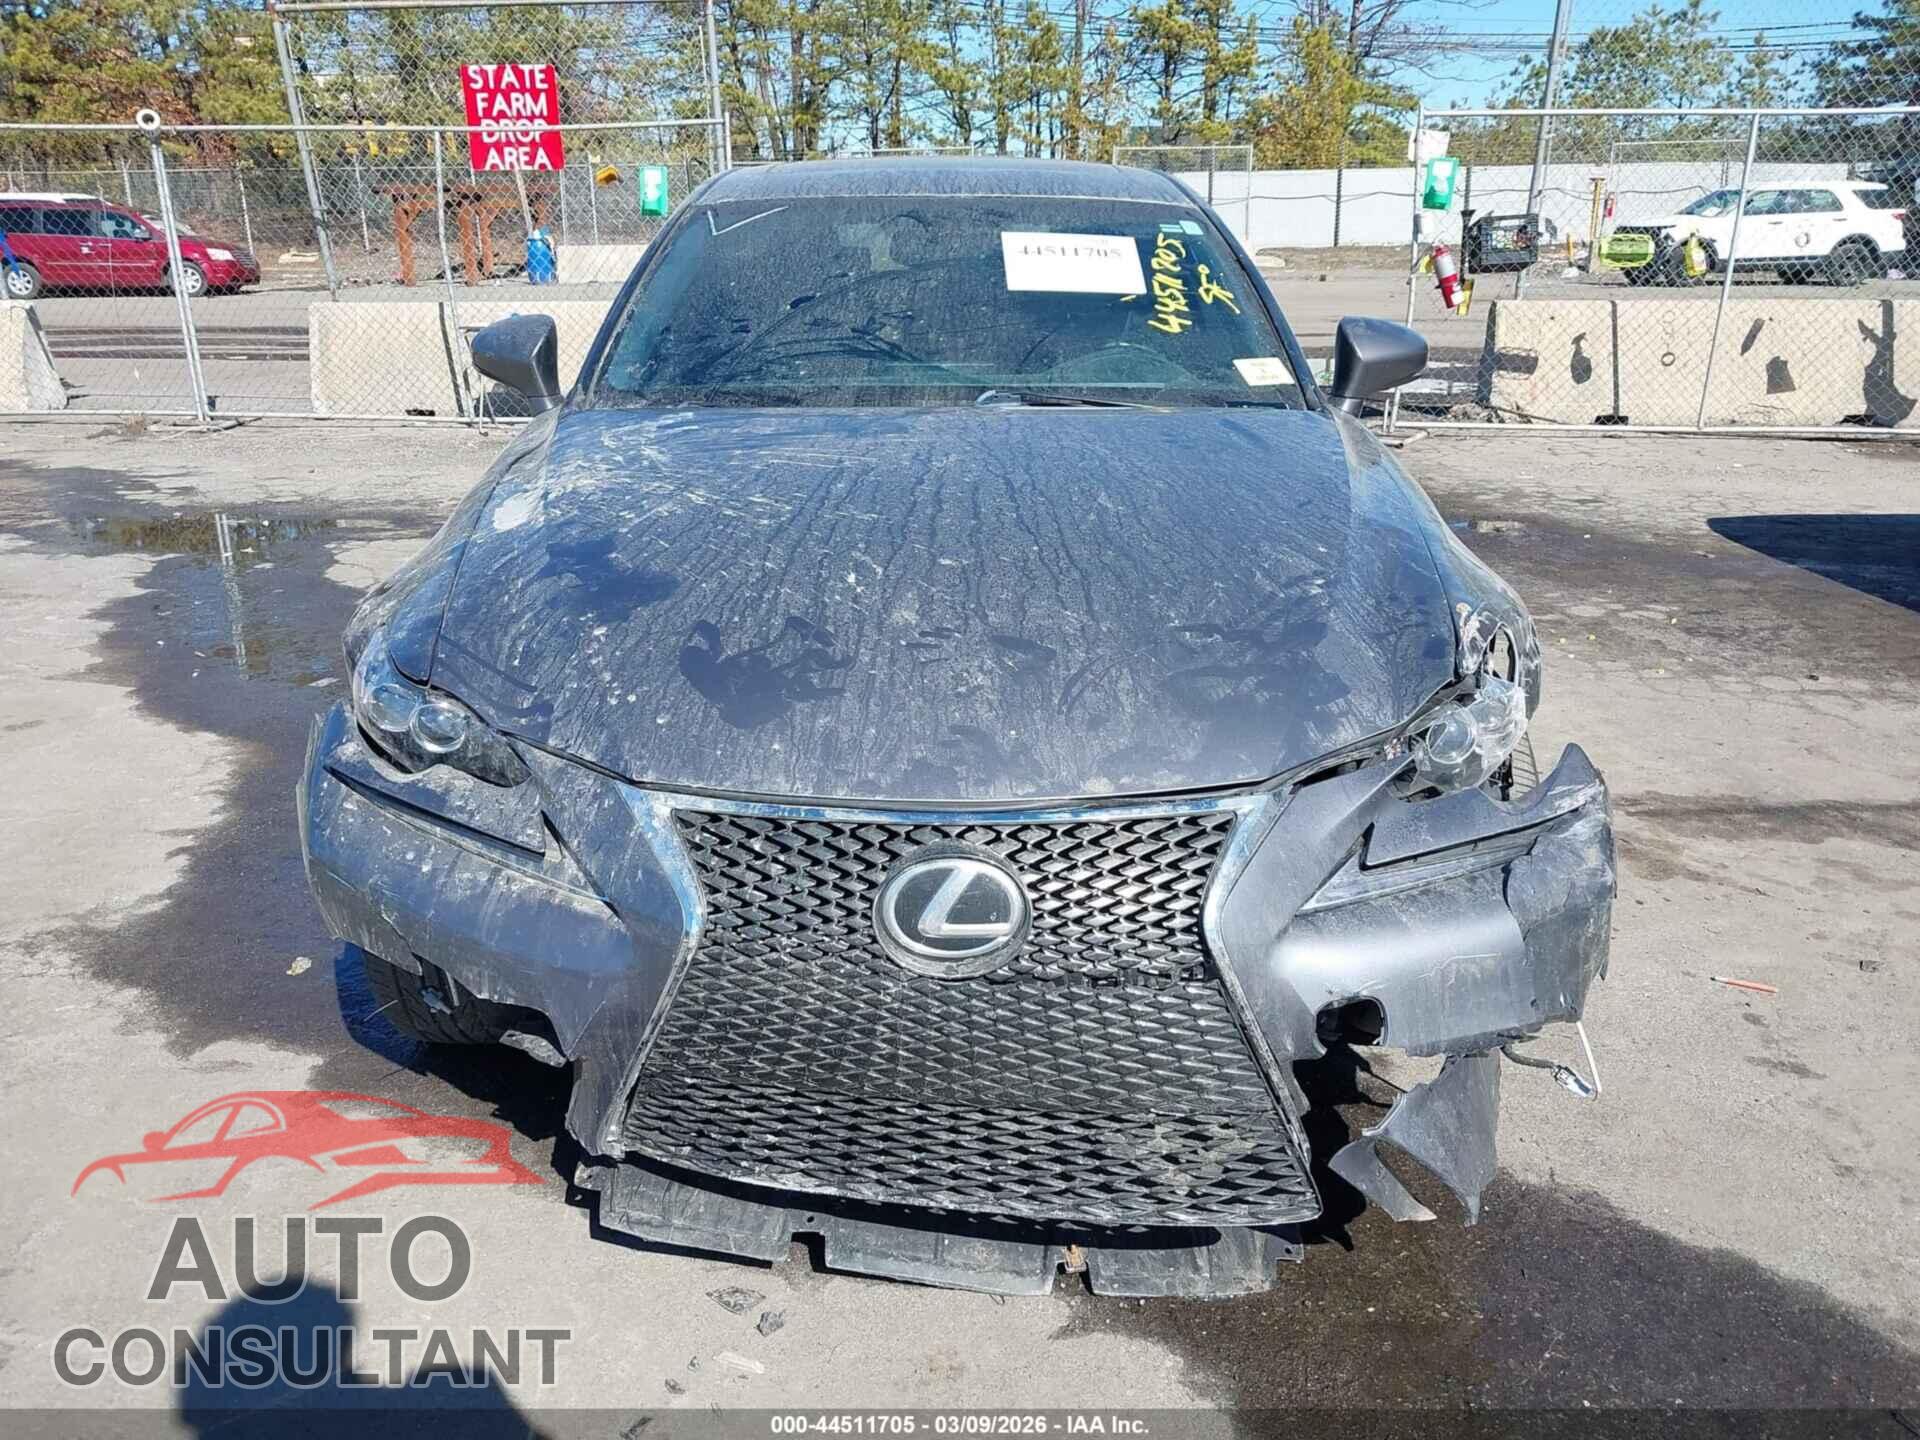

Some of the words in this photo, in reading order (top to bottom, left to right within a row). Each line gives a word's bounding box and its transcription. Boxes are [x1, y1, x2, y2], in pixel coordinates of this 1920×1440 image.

[467, 64, 549, 90] STATE
[475, 92, 548, 117] FARM
[480, 118, 548, 143] DROP
[484, 146, 553, 171] AREA
